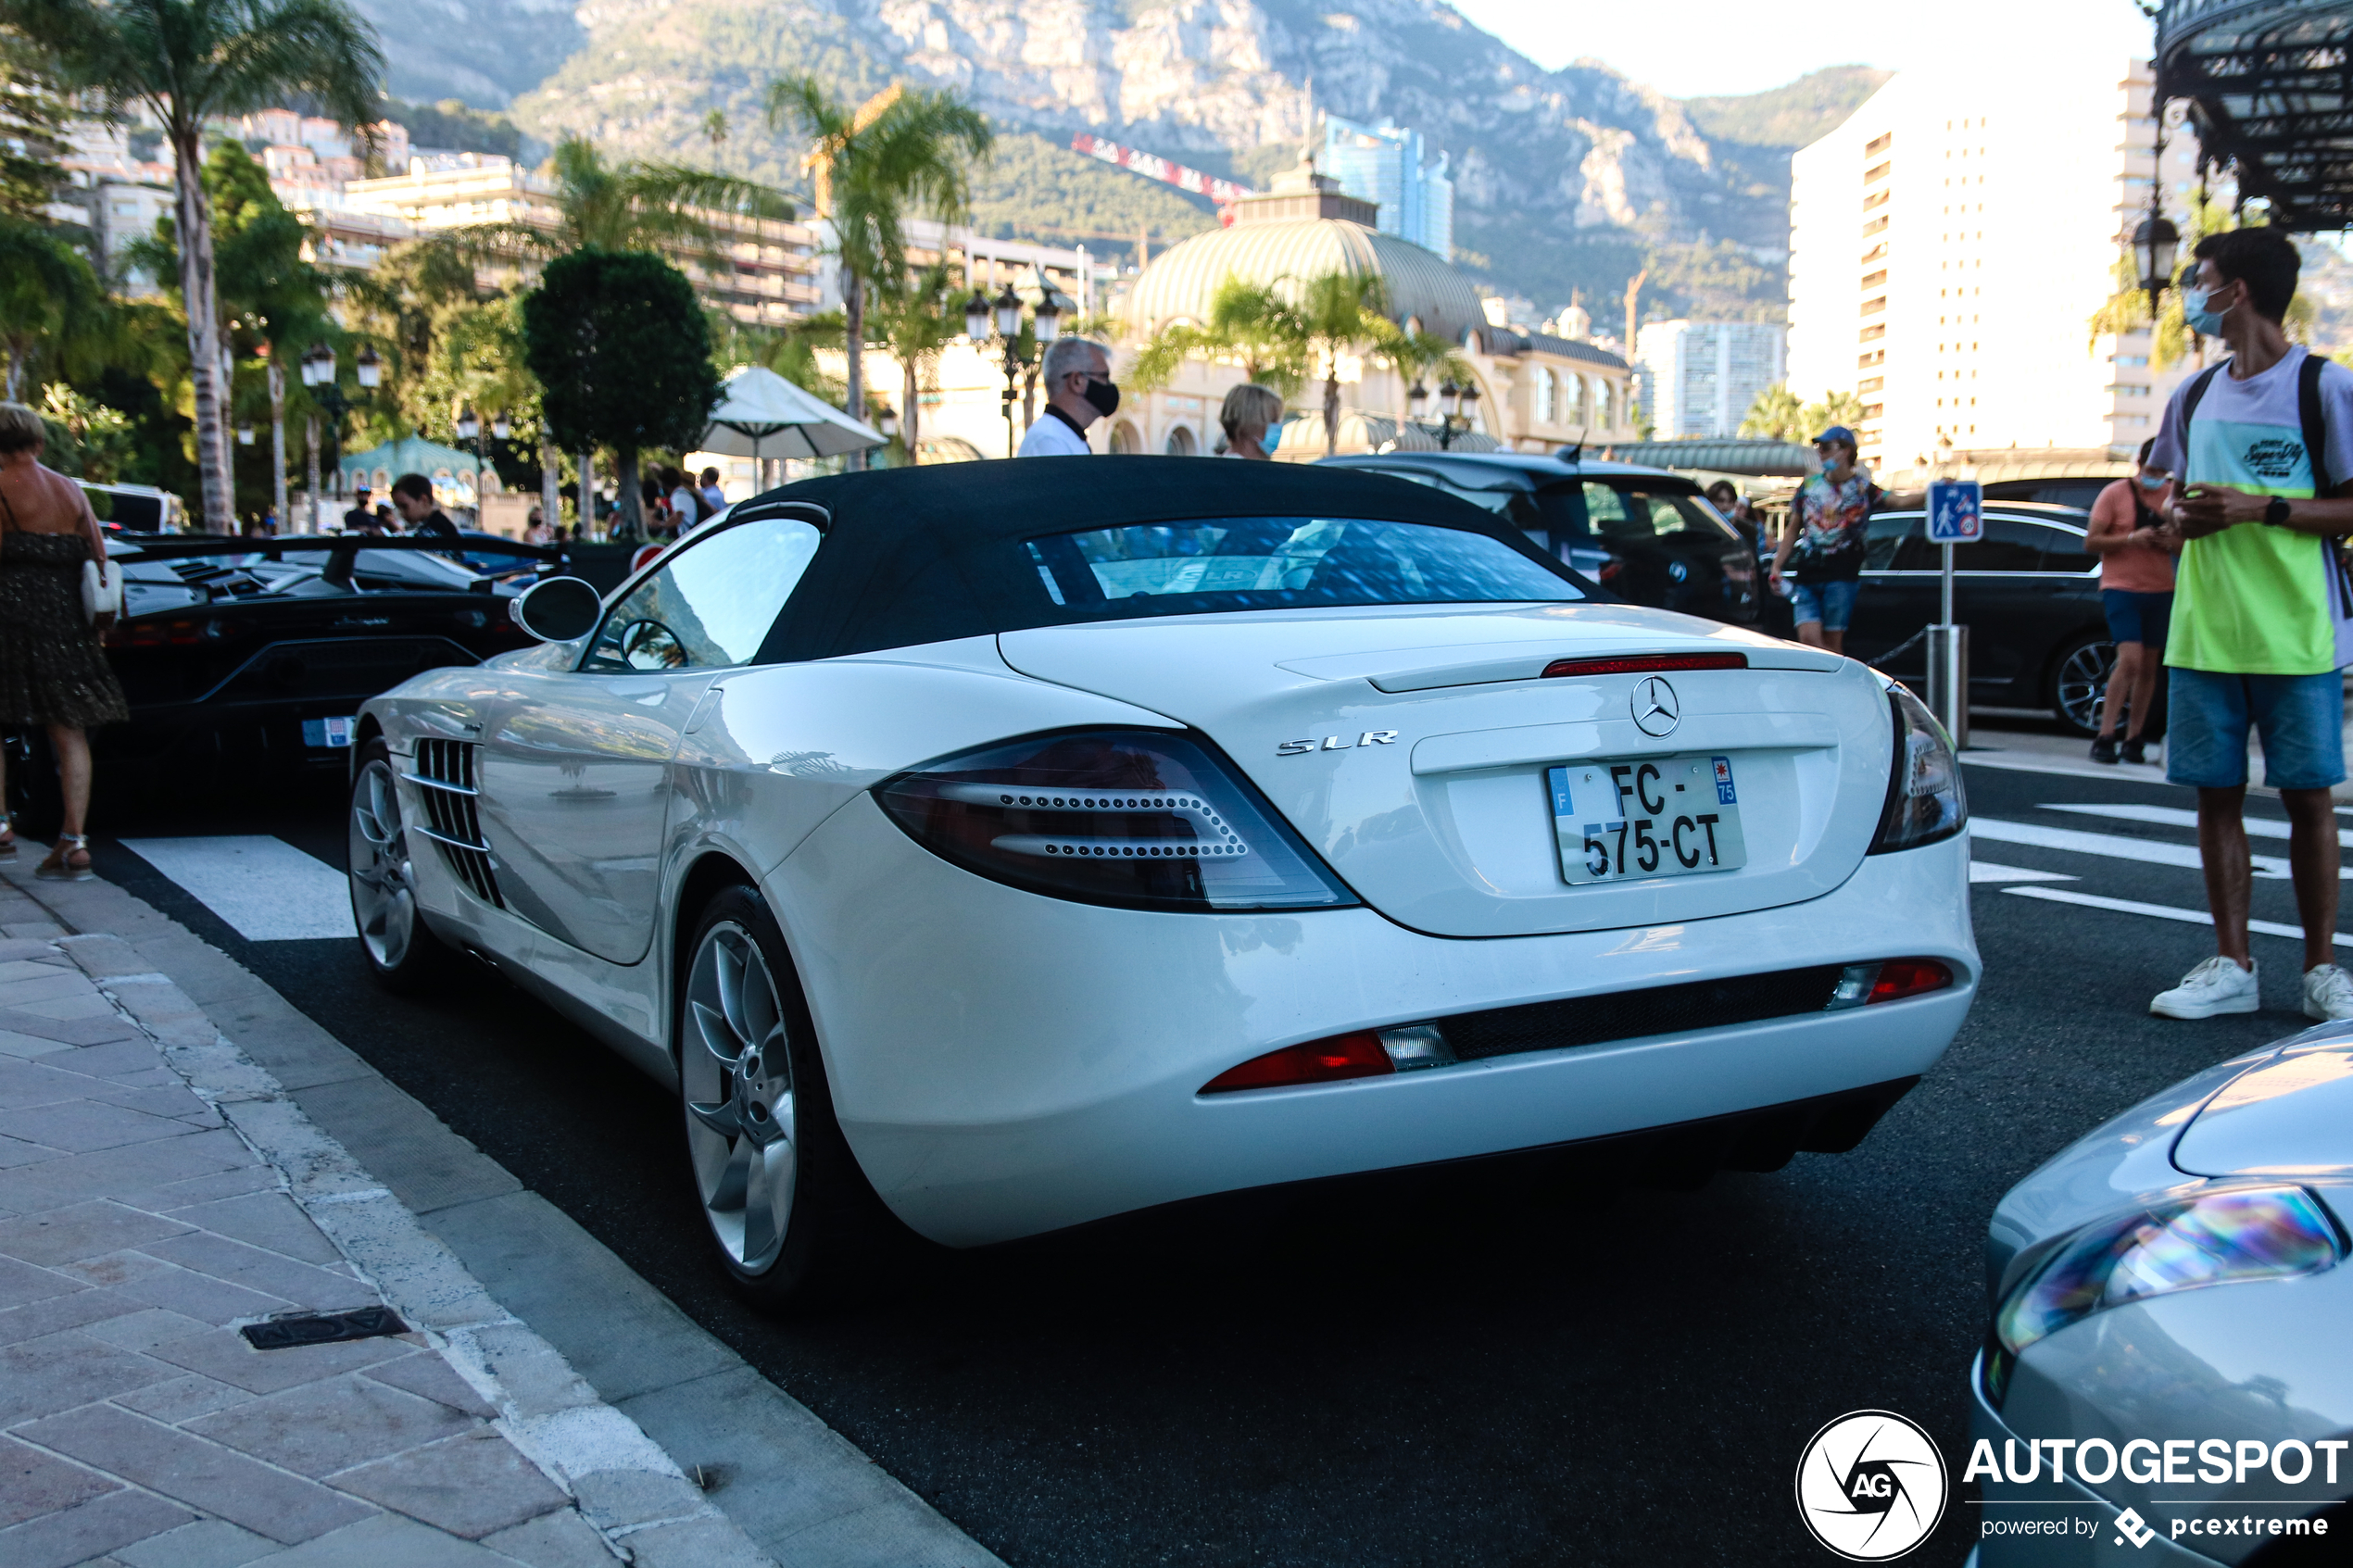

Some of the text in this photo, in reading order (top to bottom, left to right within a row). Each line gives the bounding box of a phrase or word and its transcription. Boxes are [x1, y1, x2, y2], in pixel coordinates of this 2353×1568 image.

[1277, 729, 1399, 757] SLR
[1557, 793, 1567, 809] F
[1718, 784, 1734, 801] 75
[1583, 813, 1719, 876] 575-CT
